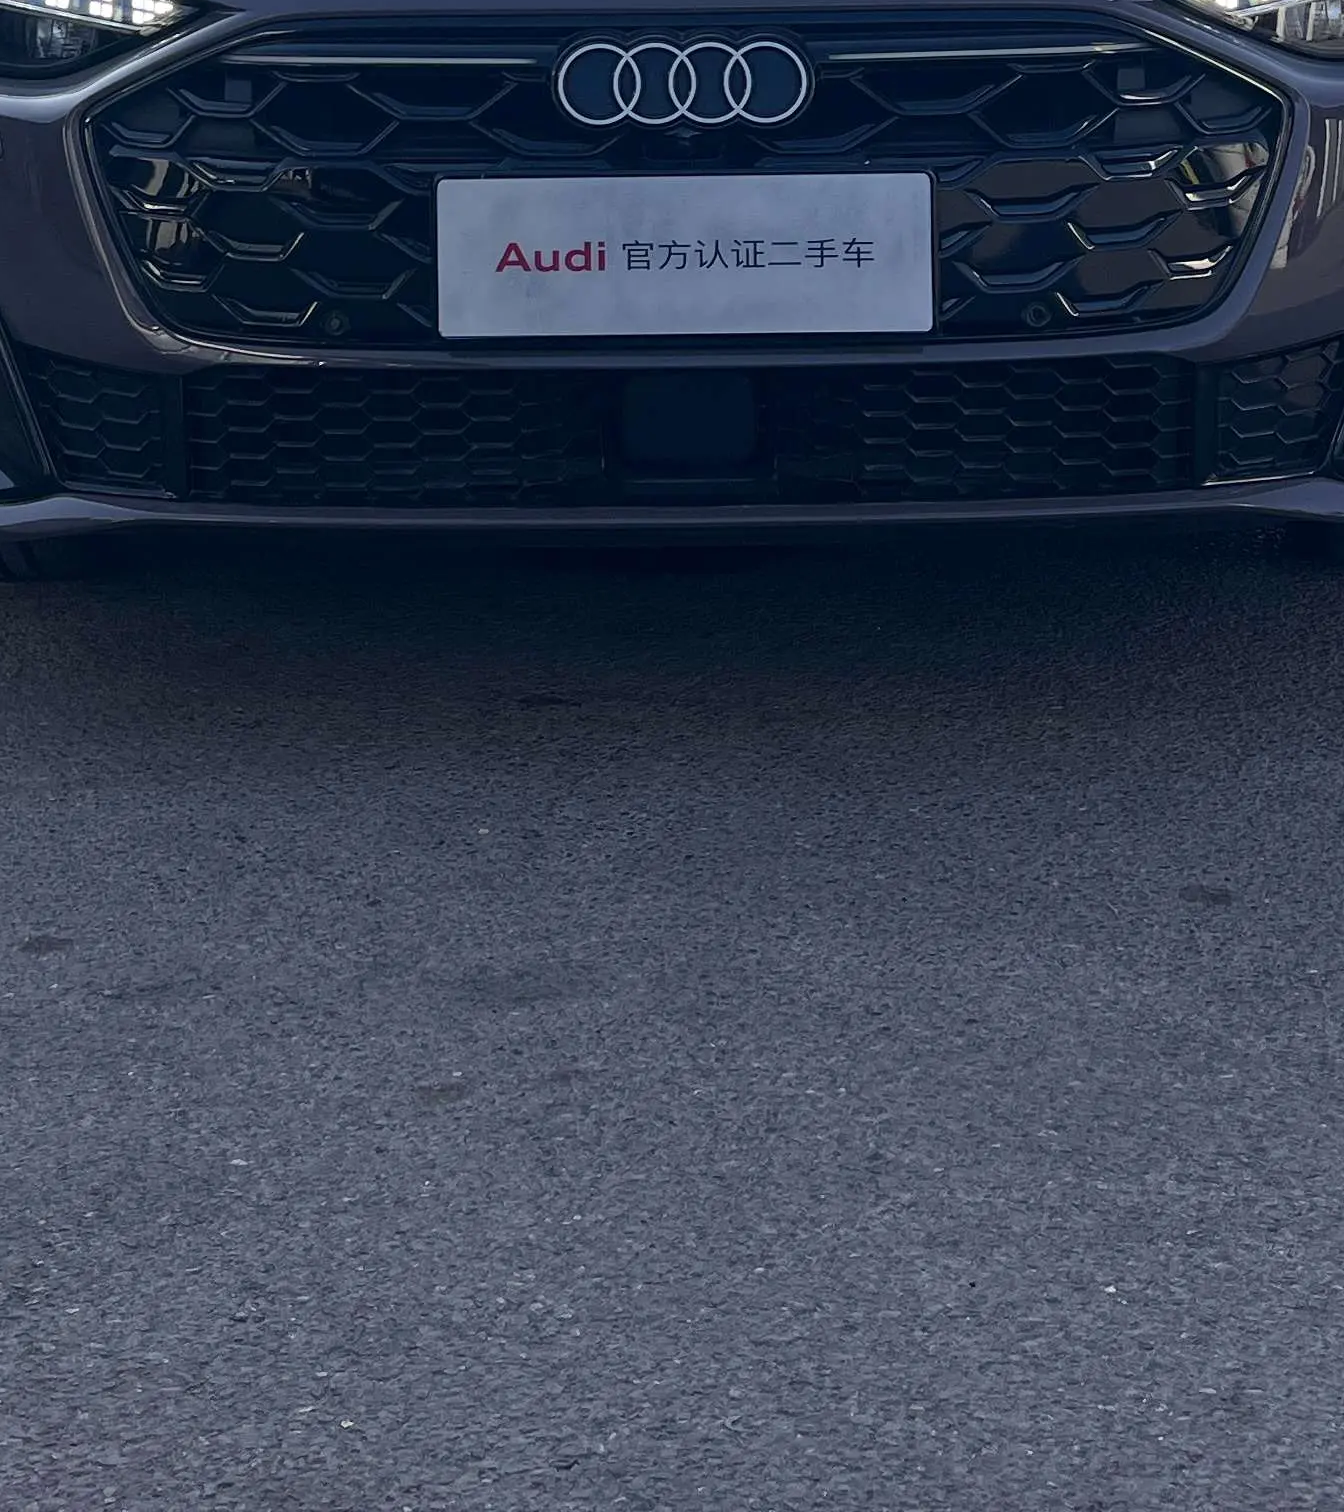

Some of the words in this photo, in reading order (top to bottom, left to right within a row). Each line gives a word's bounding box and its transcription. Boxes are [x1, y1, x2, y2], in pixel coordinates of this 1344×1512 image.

[495, 241, 606, 273] Audi
[621, 238, 875, 271] 官方认证二手车
